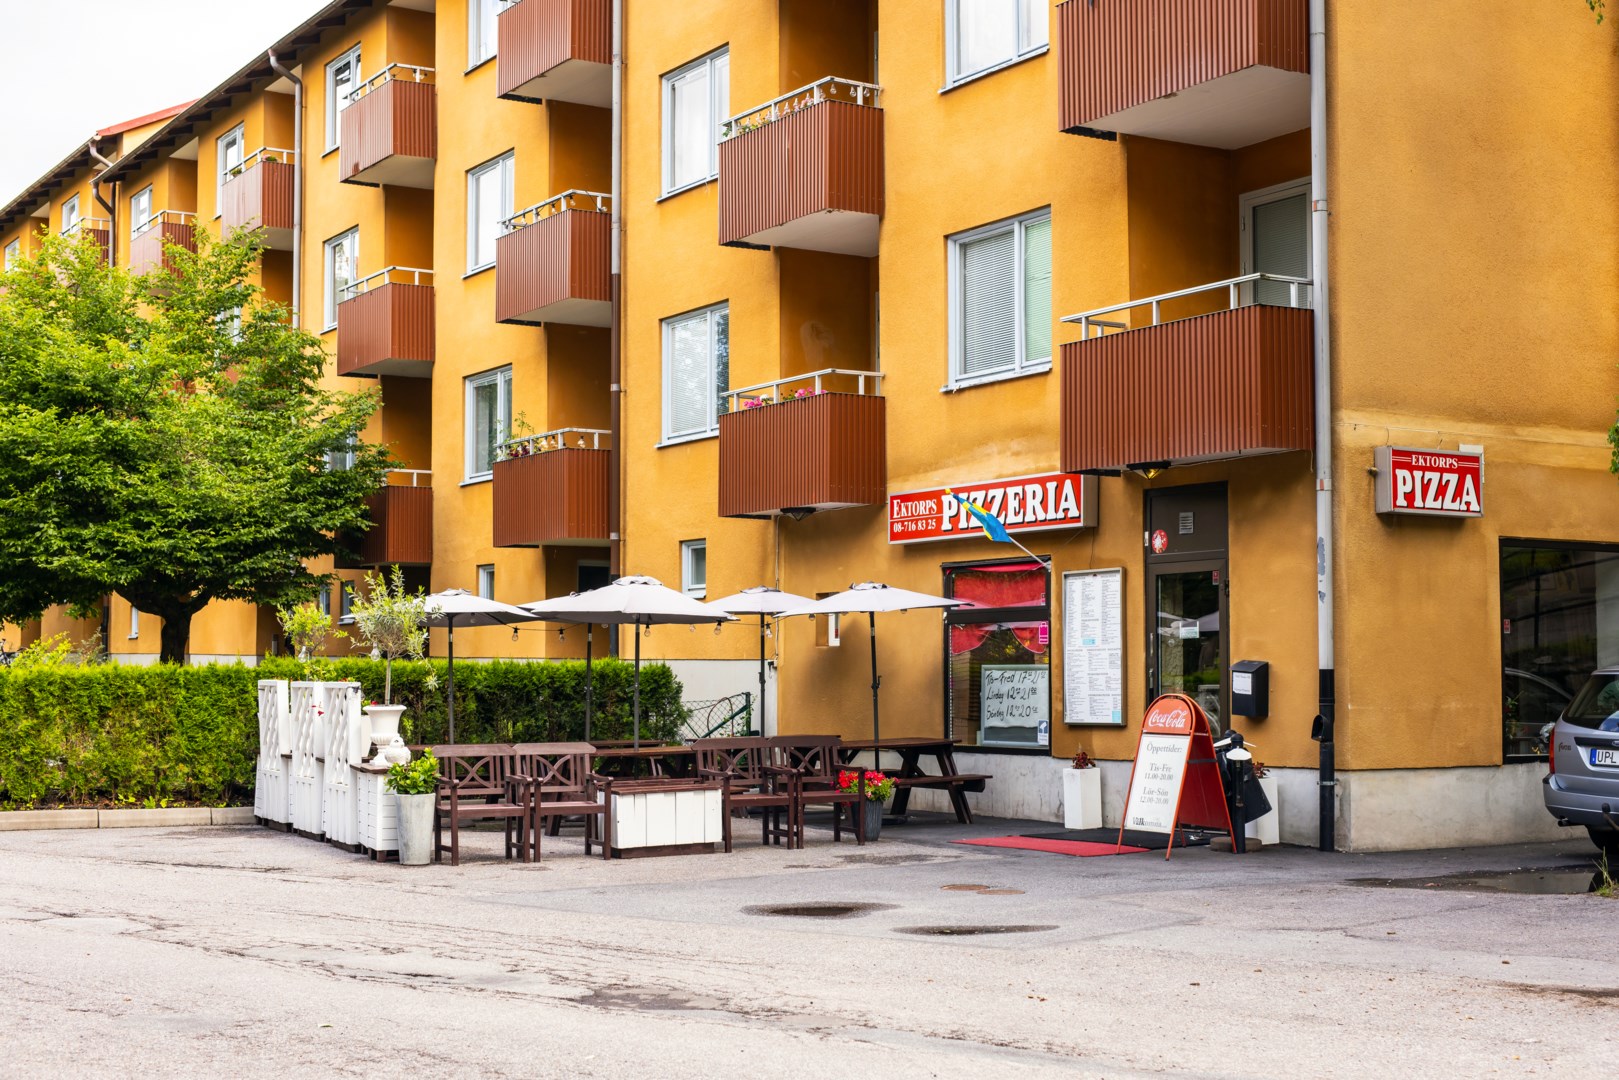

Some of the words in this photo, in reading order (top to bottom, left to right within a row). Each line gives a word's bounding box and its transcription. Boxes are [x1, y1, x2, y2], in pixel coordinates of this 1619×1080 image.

[1411, 454, 1458, 469] EKTORPS
[1395, 469, 1480, 512] PIZZA
[893, 498, 937, 519] EKTORPS
[941, 478, 1080, 532] PIZZERIA
[893, 519, 917, 533] 08-716
[917, 519, 927, 531] 83
[927, 518, 937, 530] 25
[1146, 741, 1182, 755] Öppettider:
